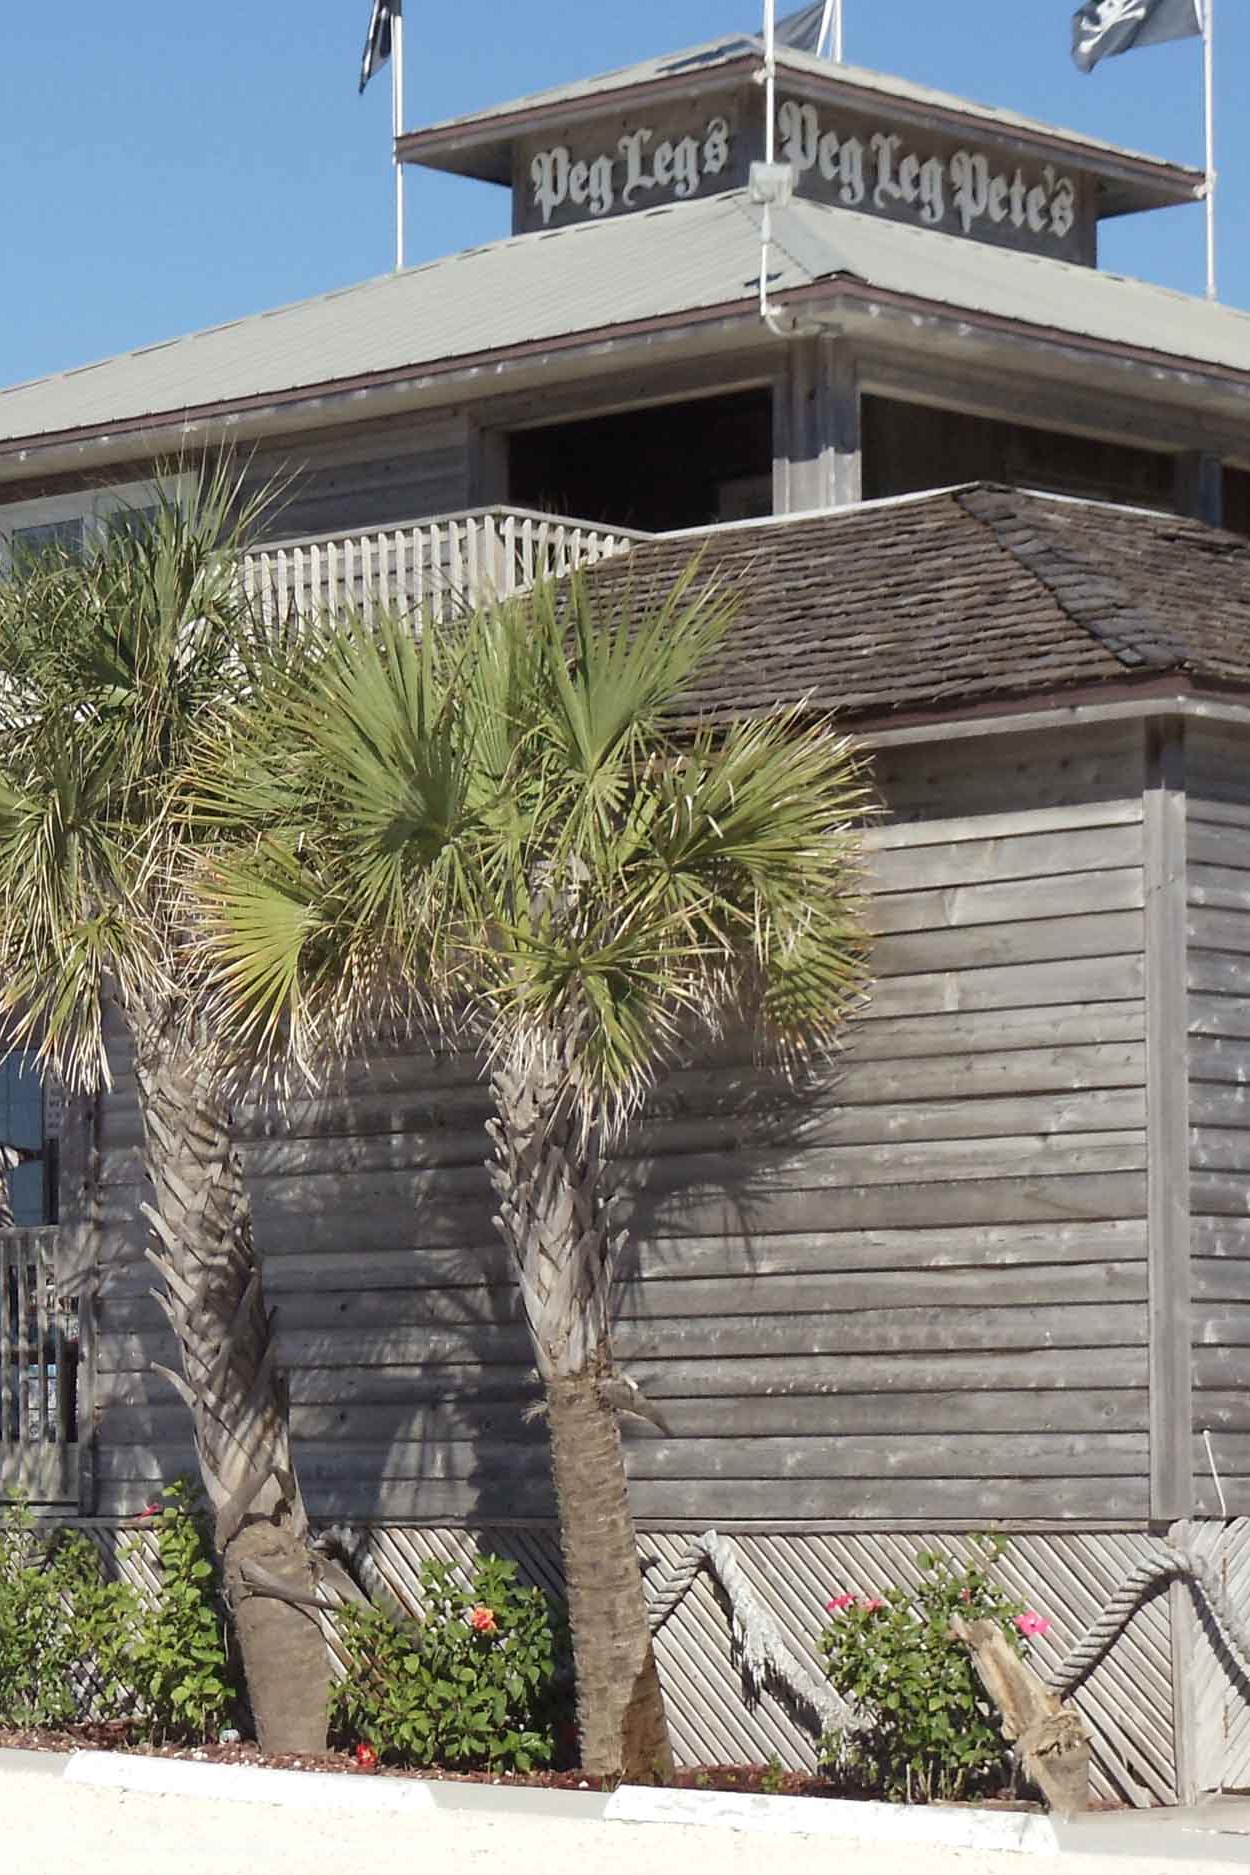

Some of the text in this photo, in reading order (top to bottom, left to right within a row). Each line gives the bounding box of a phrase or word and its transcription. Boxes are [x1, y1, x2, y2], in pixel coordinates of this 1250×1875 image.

[531, 144, 614, 224] Peg
[778, 101, 1075, 238] Peg Leg Pete's
